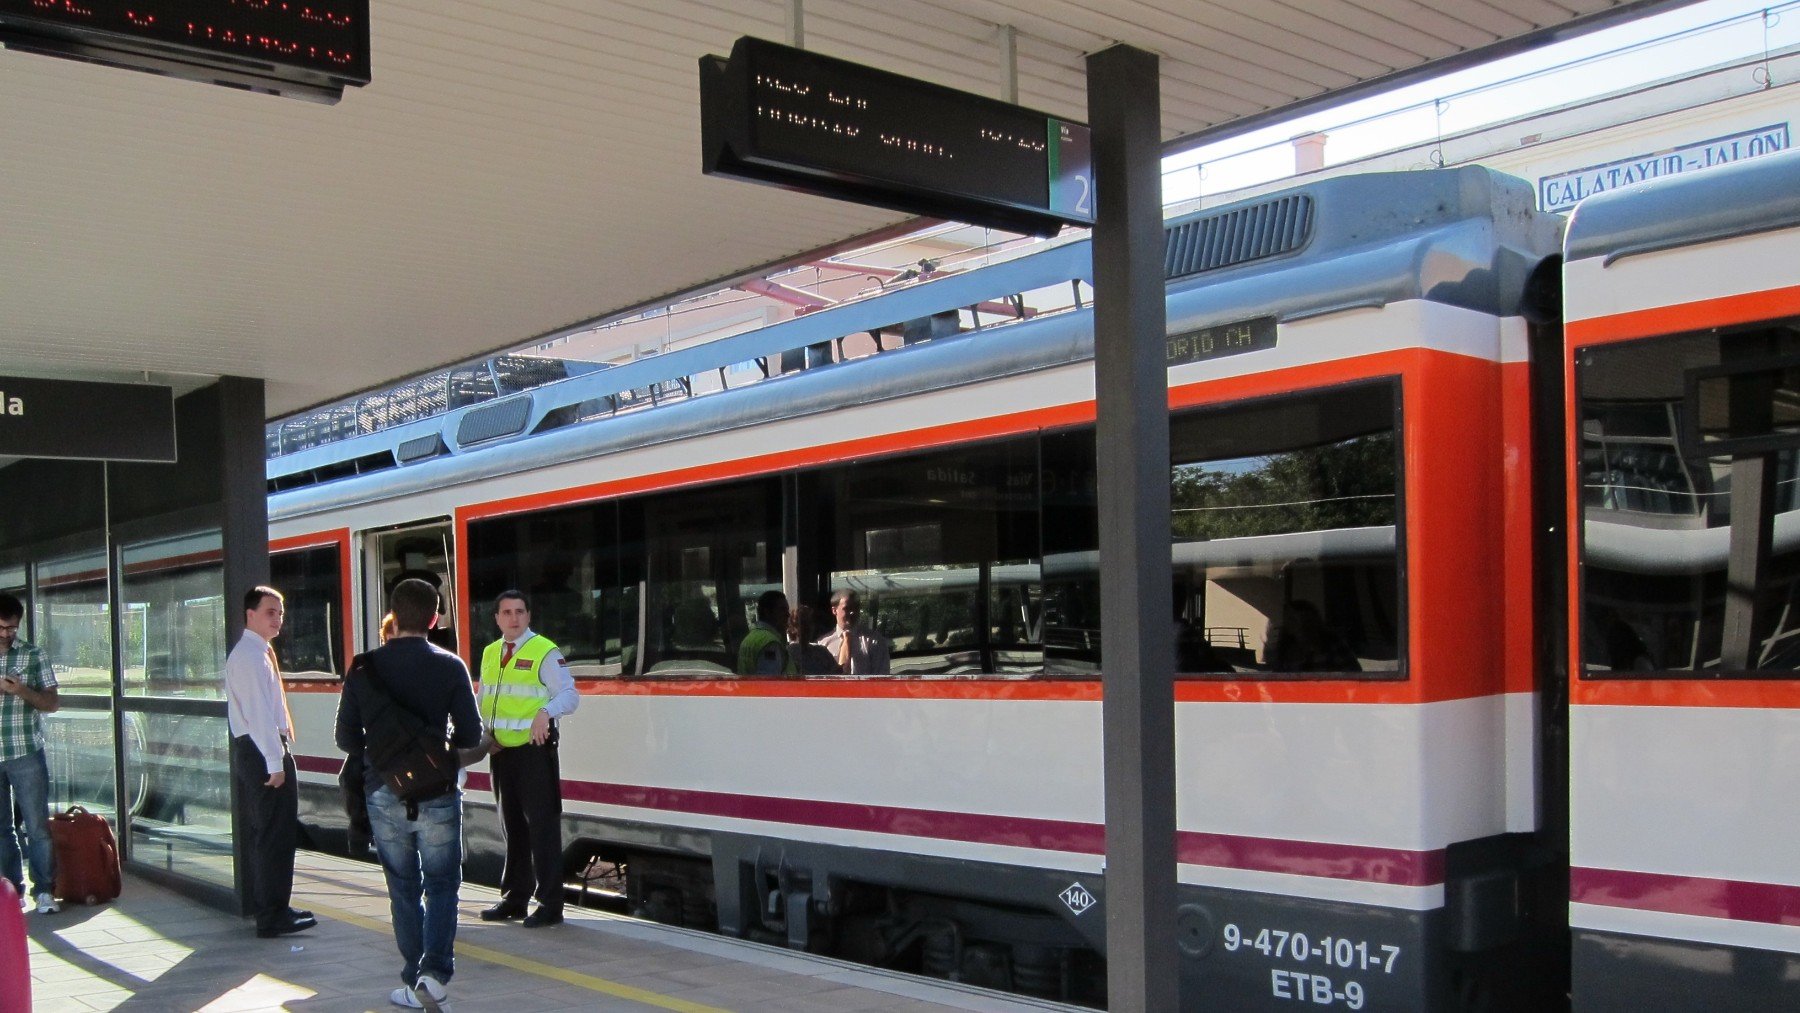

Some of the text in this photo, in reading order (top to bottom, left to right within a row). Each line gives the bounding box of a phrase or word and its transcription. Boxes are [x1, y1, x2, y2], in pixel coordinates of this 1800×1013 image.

[1074, 174, 1089, 214] 2
[1066, 890, 1089, 907] 140
[1223, 923, 1400, 974] 9-470-101-7
[1271, 969, 1365, 1010] ETB-9
